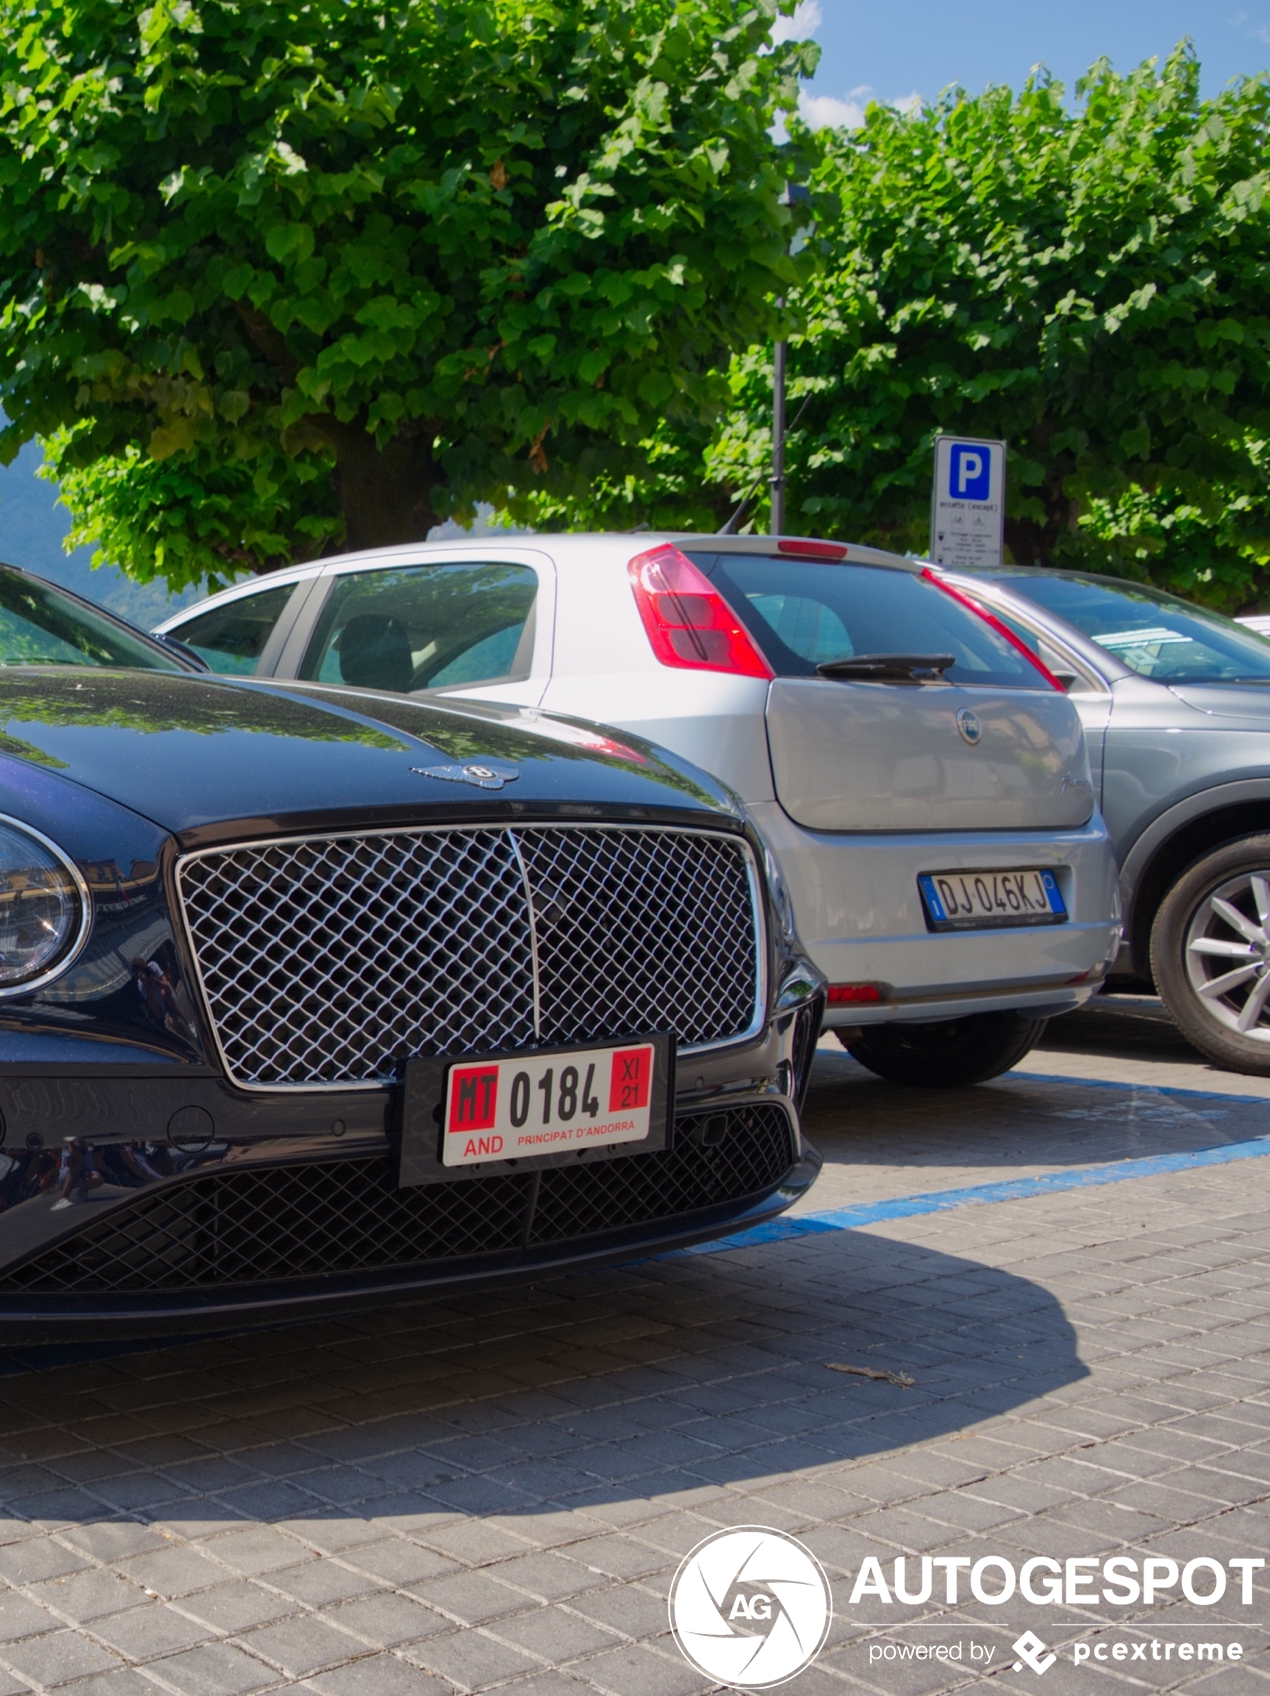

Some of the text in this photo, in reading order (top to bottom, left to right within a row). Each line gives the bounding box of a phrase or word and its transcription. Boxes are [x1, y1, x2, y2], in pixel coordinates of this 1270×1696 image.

[958, 451, 983, 493] P
[621, 1057, 640, 1081] XI
[456, 1063, 599, 1128] MT 0184
[621, 1083, 639, 1108] 21
[517, 1120, 635, 1146] PRINCIPAT D'ANDORRA
[463, 1135, 504, 1157] AND
